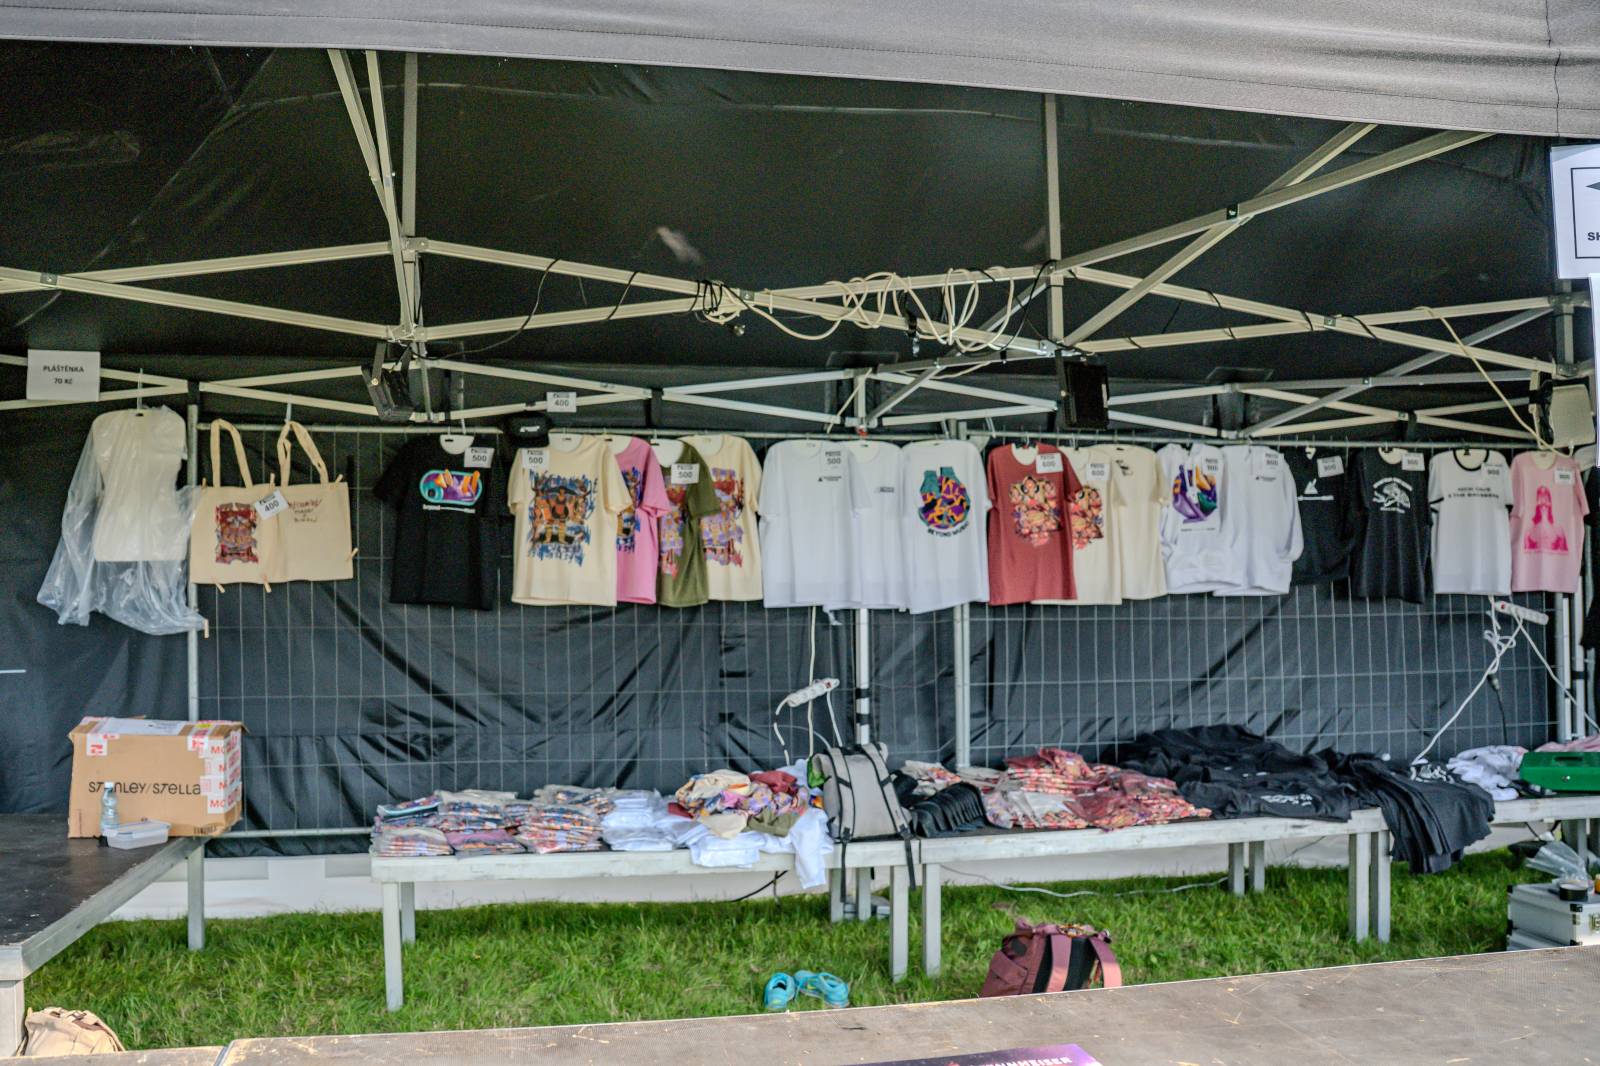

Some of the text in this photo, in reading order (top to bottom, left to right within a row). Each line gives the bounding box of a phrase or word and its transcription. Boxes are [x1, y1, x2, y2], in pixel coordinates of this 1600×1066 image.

[554, 399, 570, 407] 400
[528, 456, 543, 464] 500
[264, 499, 280, 512] 400
